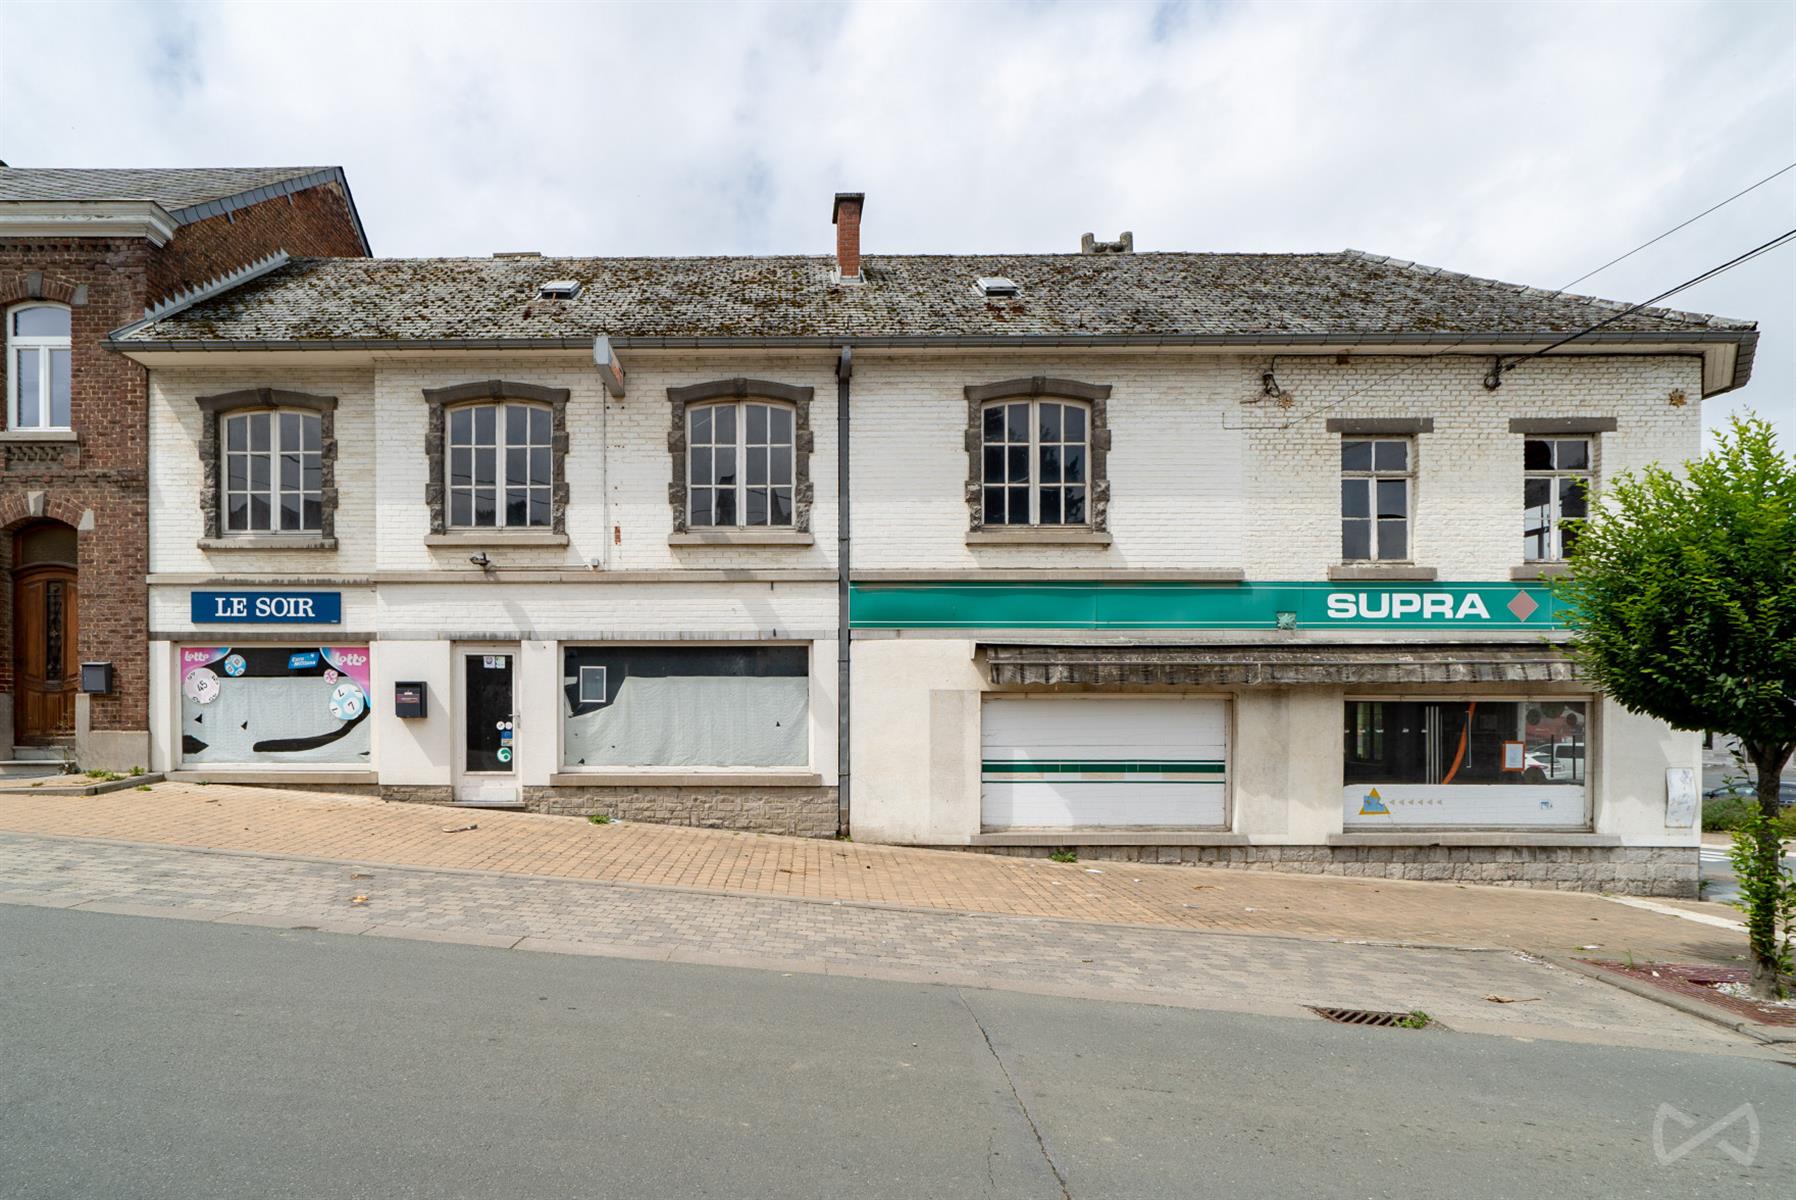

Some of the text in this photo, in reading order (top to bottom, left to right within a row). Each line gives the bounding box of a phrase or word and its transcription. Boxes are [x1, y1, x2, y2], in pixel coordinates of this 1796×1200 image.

[215, 597, 315, 618] LE SOIR
[1326, 593, 1490, 619] SUPRA
[197, 680, 208, 692] 45
